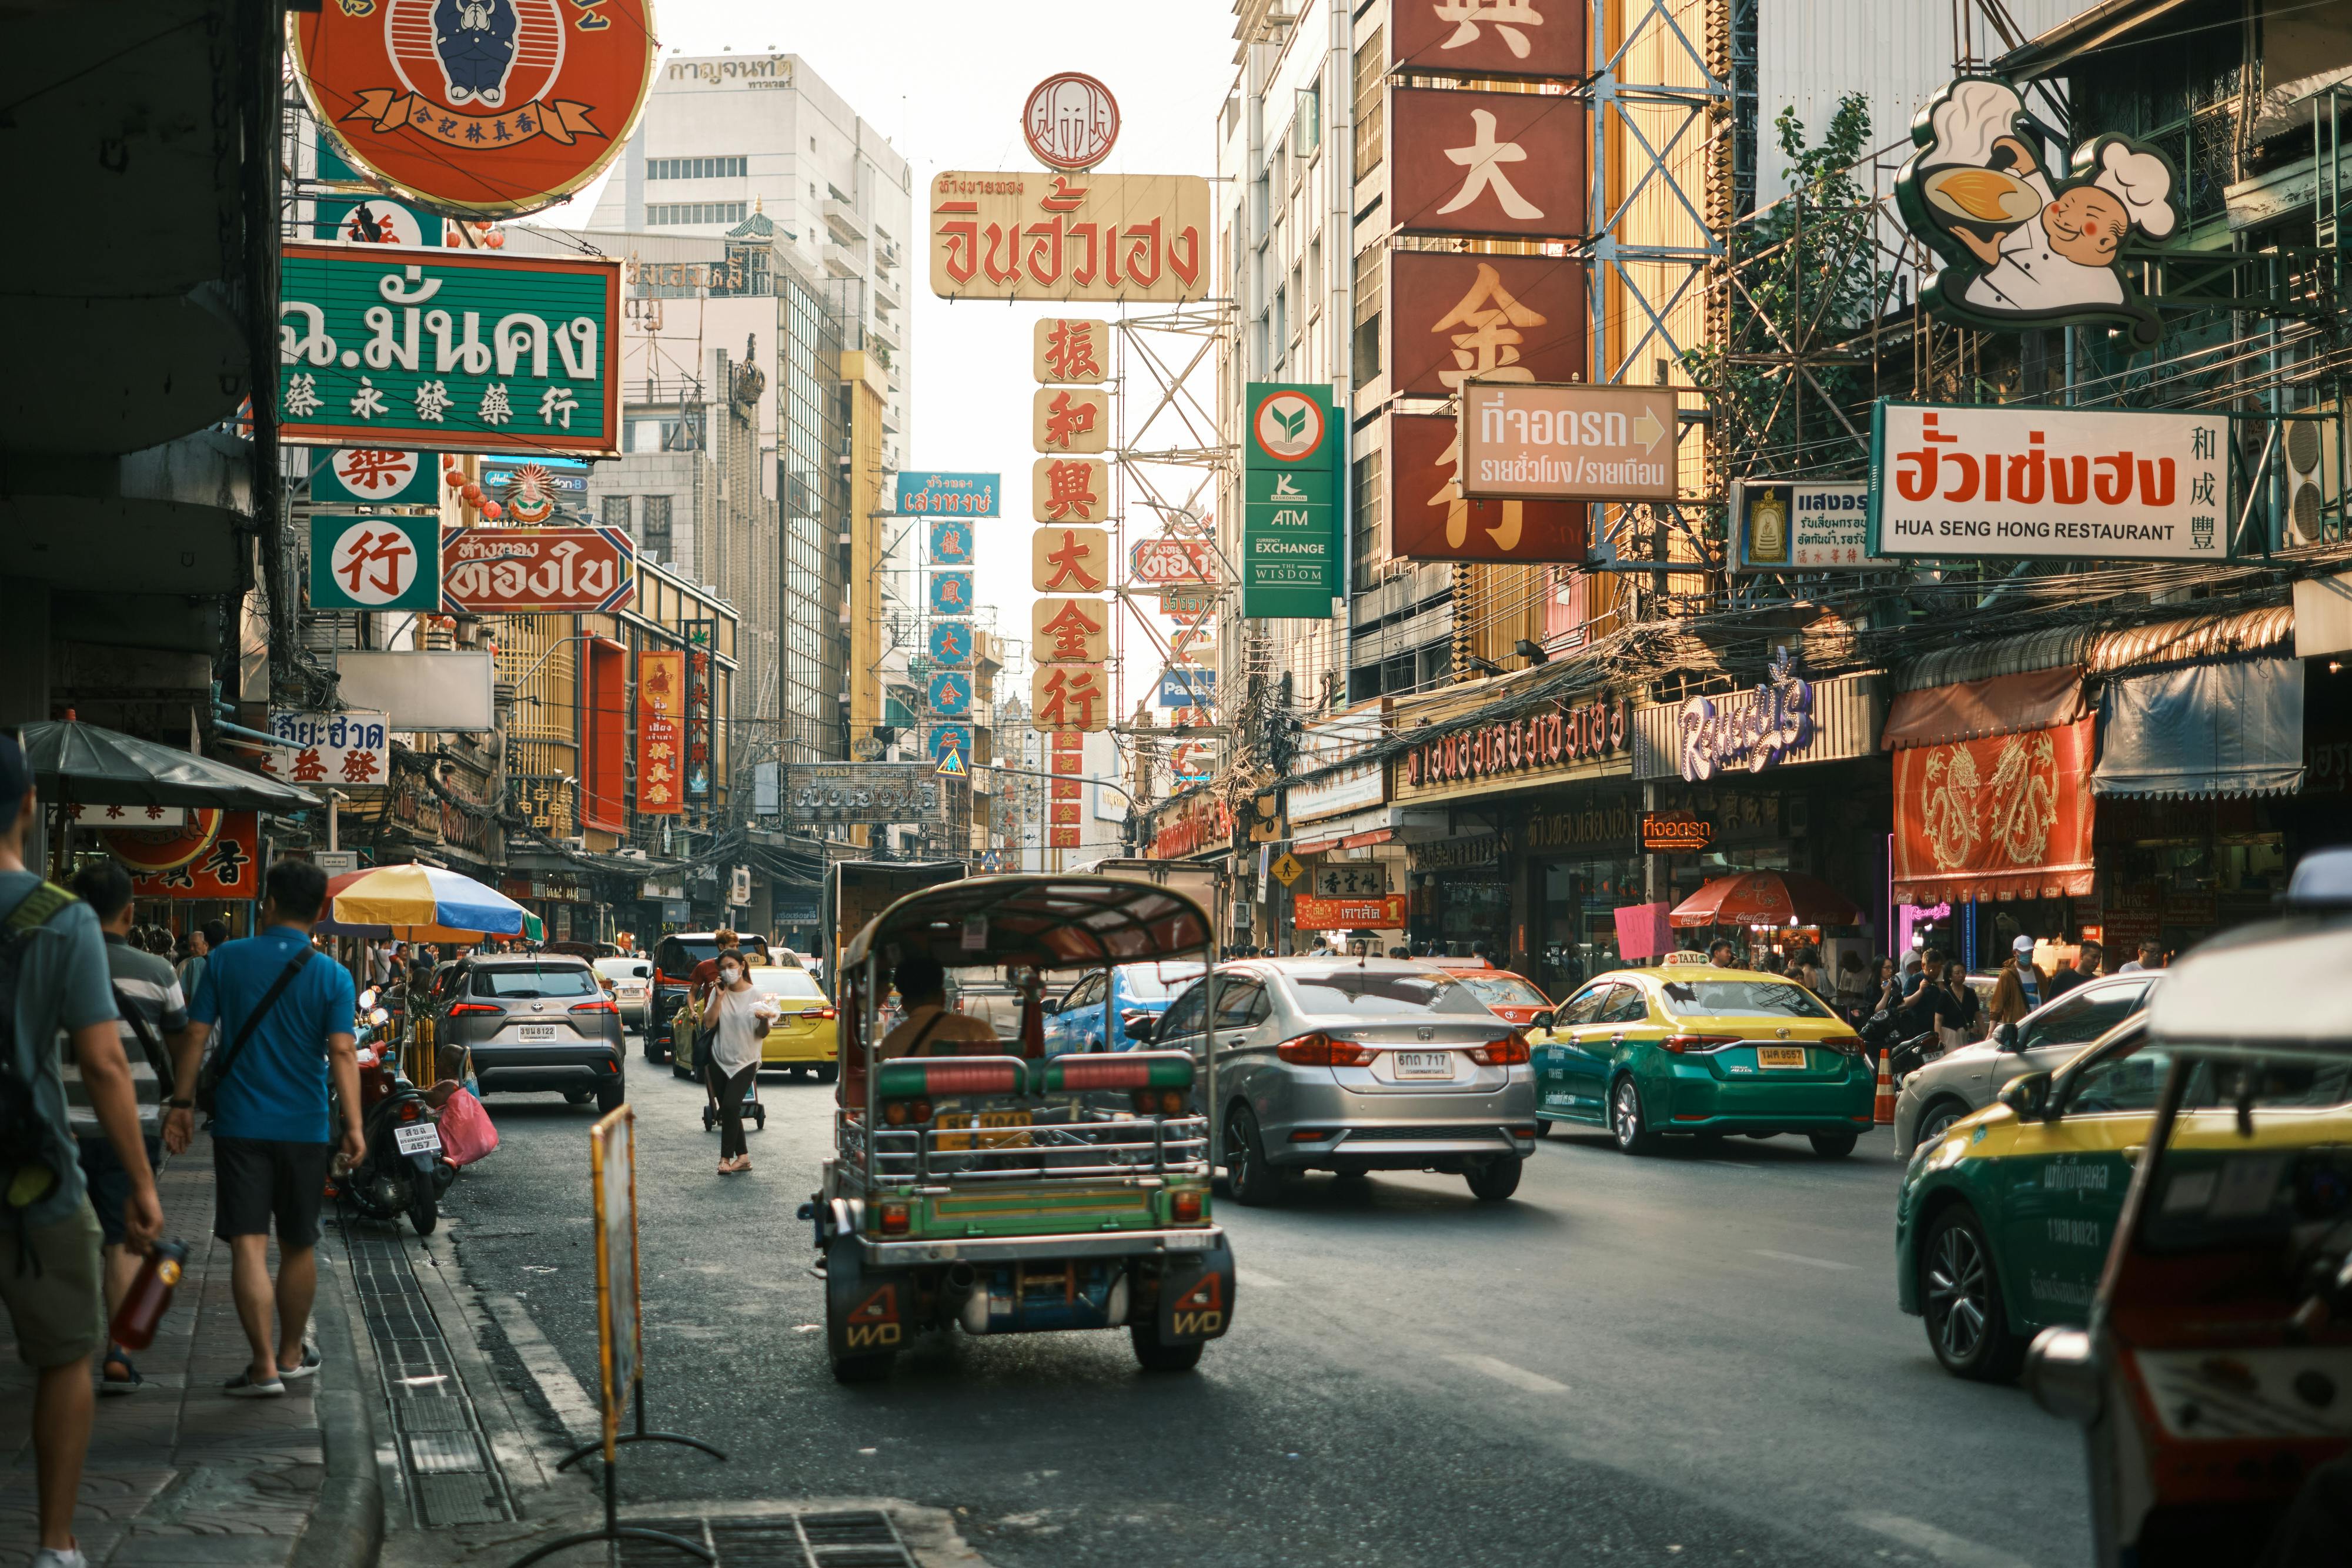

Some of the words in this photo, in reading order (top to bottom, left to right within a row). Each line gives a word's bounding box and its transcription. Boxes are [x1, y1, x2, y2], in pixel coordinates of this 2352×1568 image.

[938, 172, 1024, 195] ห้างขายทอง
[1481, 392, 1627, 447] ที่จอดรถ
[1896, 413, 2175, 507] ฮั่วเซ่งฮง
[1276, 473, 1302, 495] K
[2189, 424, 2217, 551] 和成豐
[1040, 319, 1102, 730] 振和興大金行
[1271, 510, 1308, 526] ATM
[1895, 519, 1934, 536] HUA
[1939, 521, 1991, 537] SENG
[1997, 522, 2050, 538] HONG
[2054, 524, 2175, 541] RESTAURANT
[1255, 543, 1325, 554] EXCHANGE
[448, 539, 614, 599] ทองใบ
[1256, 570, 1322, 580] WISDOM
[1643, 813, 1710, 837] ที่จอดรถ
[1341, 904, 1381, 920] เกาลัด
[1678, 954, 1698, 964] TAXI
[1426, 1054, 1446, 1066] 717
[1780, 1049, 1801, 1059] 9557
[410, 1141, 430, 1150] 457
